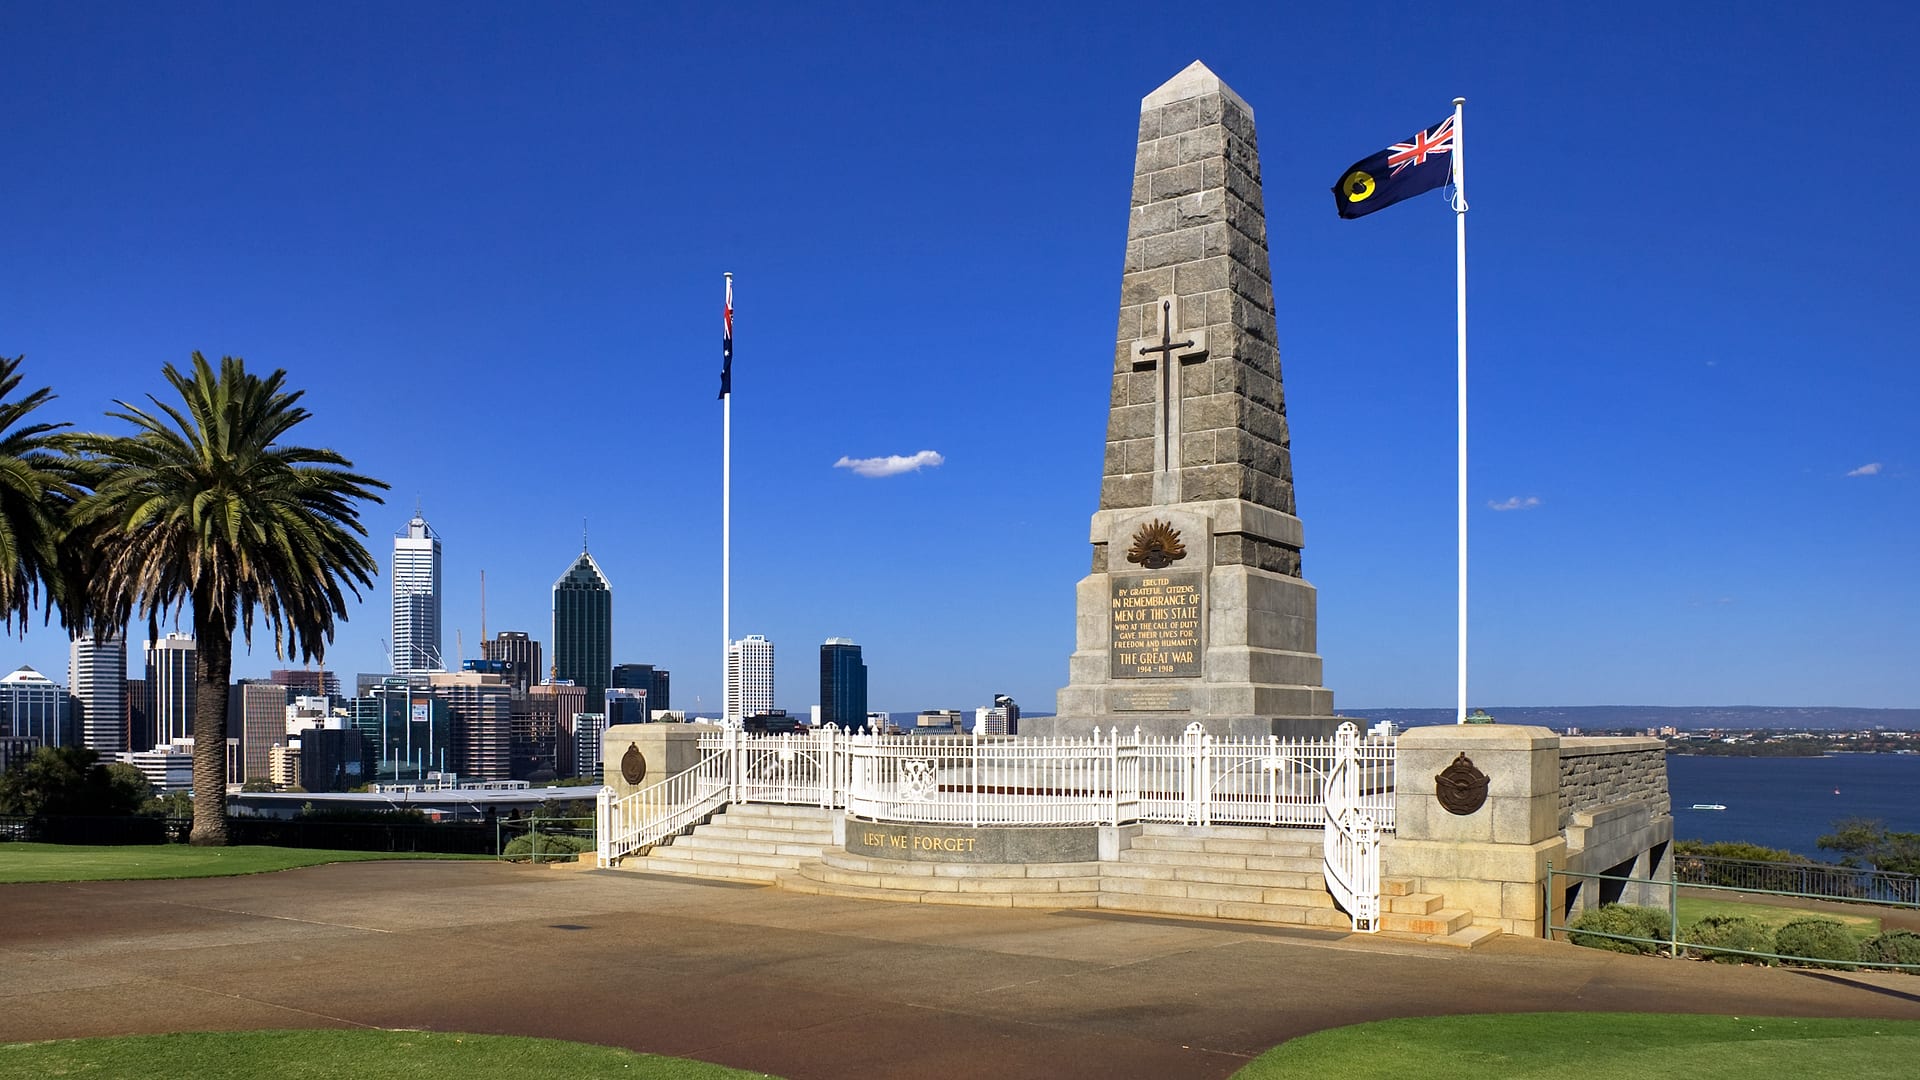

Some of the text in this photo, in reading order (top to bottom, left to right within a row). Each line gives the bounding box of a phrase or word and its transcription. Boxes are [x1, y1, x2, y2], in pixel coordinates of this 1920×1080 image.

[1142, 578, 1169, 586] ERECTED
[1166, 585, 1194, 594] CITIZENS
[1113, 594, 1200, 608] IN REMEMBRANCE OF
[1115, 607, 1198, 622] MEN OF THIS STATE
[1120, 651, 1193, 664] THE GREAT WAR
[864, 833, 976, 852] LEST WE FORGET
